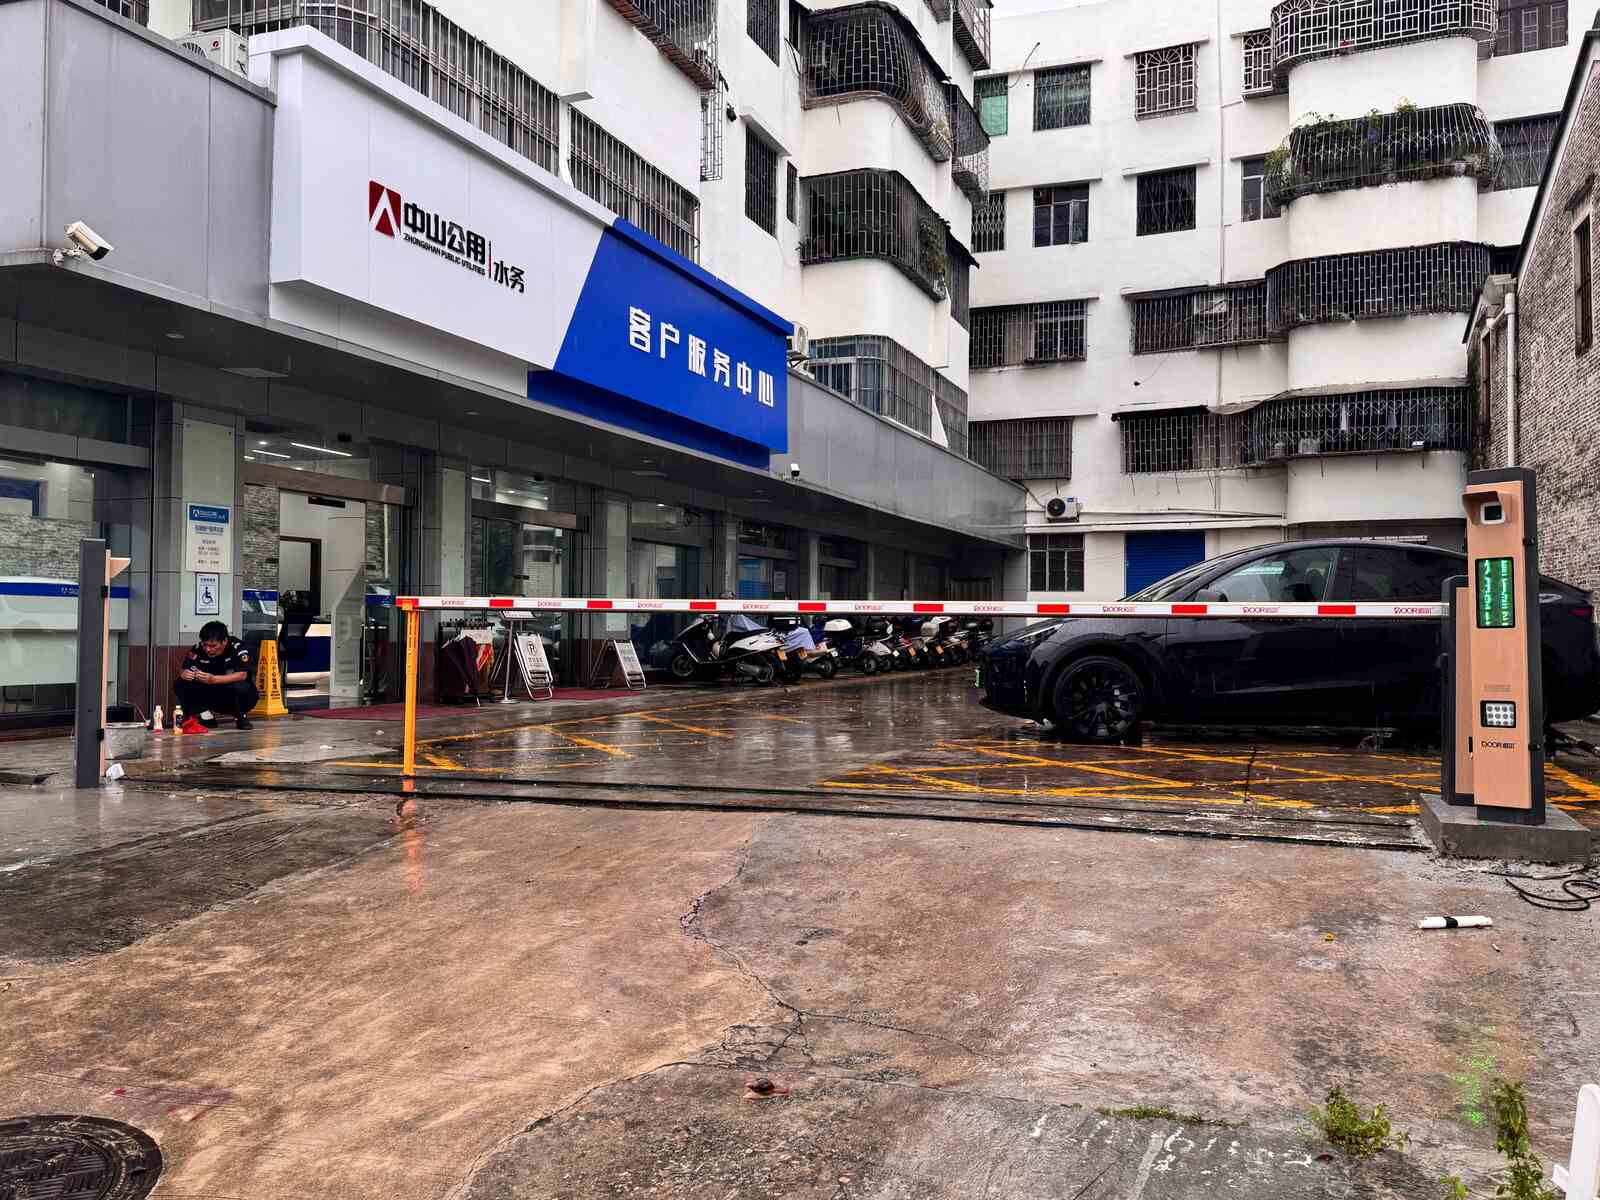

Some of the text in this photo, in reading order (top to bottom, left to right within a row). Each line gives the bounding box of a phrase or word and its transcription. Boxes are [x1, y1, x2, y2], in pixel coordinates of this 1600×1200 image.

[403, 232, 486, 276] ZHONGSHAN PUBLIC UTILITIES
[404, 202, 486, 265] 中山公用
[493, 260, 525, 293] 水务
[629, 305, 775, 408] 客户服务中心
